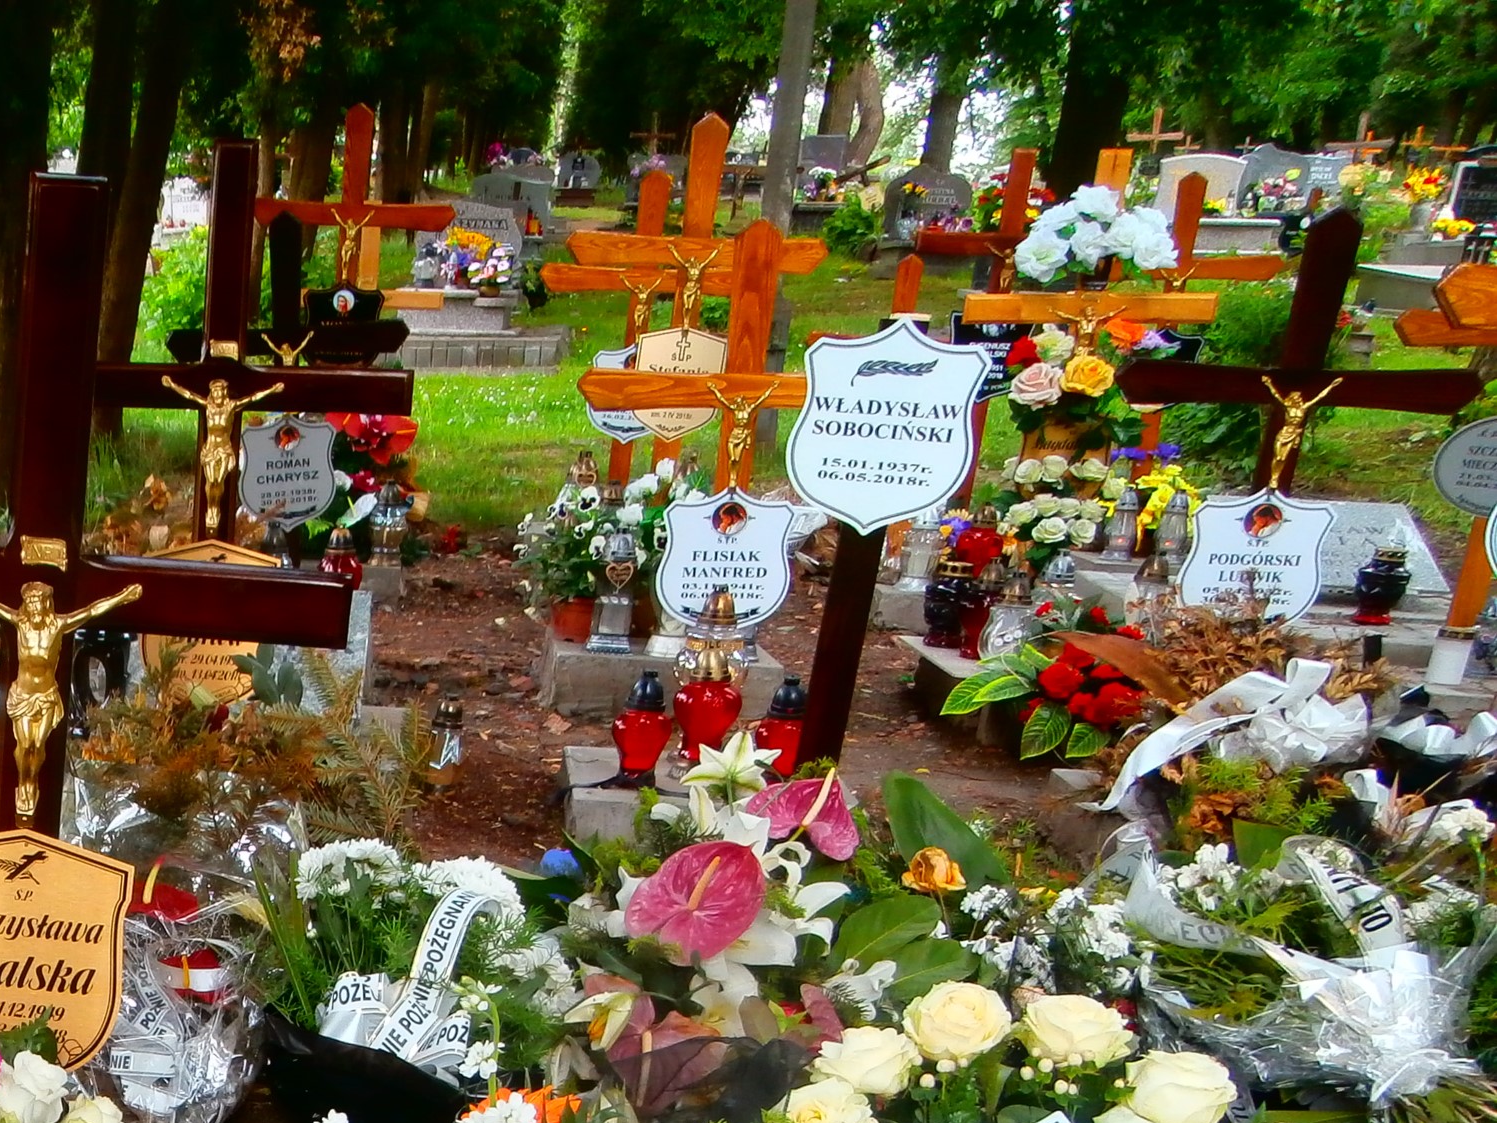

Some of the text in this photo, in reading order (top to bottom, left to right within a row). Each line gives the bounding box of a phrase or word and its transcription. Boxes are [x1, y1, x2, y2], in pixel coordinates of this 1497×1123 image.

[813, 396, 963, 421] WŁADYSŁAW
[812, 418, 953, 444] SOBOCIŃSKI
[266, 458, 310, 470] ROMAN
[821, 456, 934, 475] 15.01.1937r.
[256, 470, 319, 485] CHARYSZ
[817, 470, 931, 487] 06.05.2018r.
[692, 551, 762, 562] FLISIAK
[1208, 551, 1302, 567] PODGÓRSKI
[682, 567, 768, 578] MANFRED
